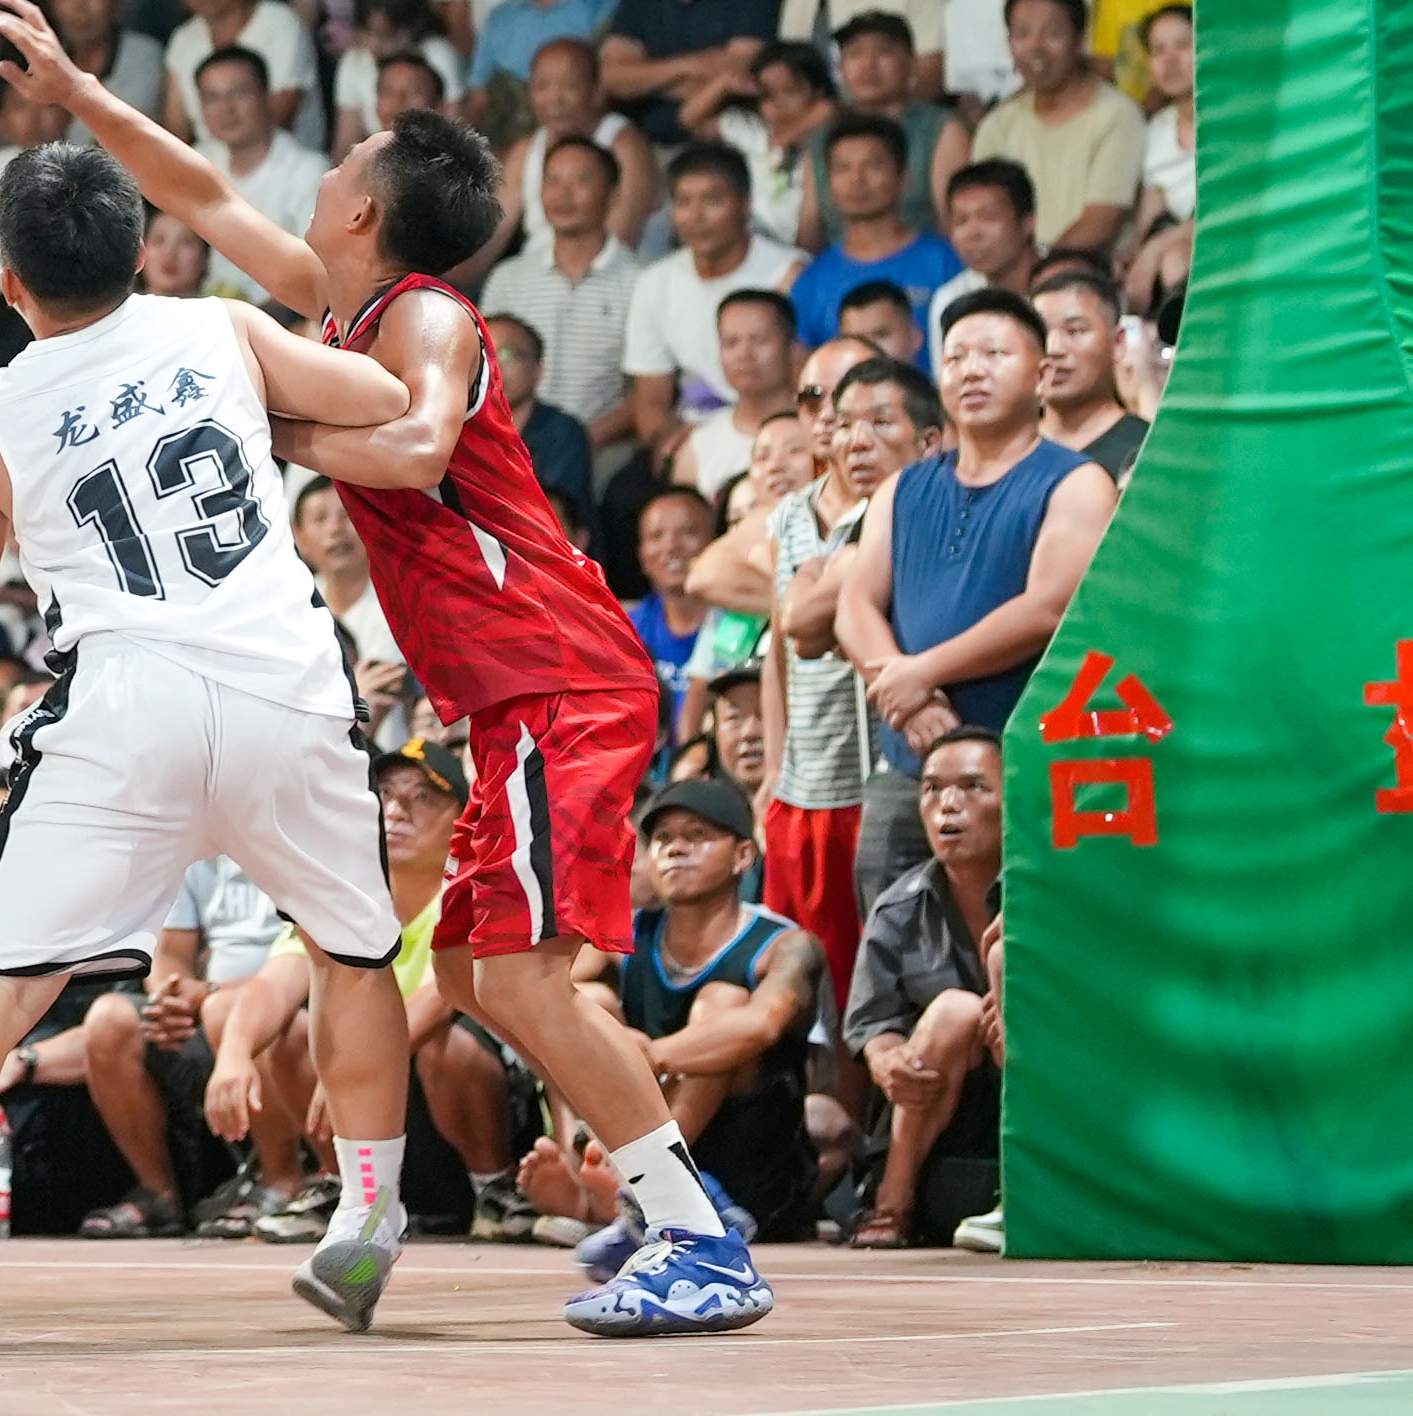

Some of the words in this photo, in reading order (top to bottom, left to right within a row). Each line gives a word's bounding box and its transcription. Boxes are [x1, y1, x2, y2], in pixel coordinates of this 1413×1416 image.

[52, 367, 217, 455] 龙盛鑫
[66, 418, 271, 601] 13
